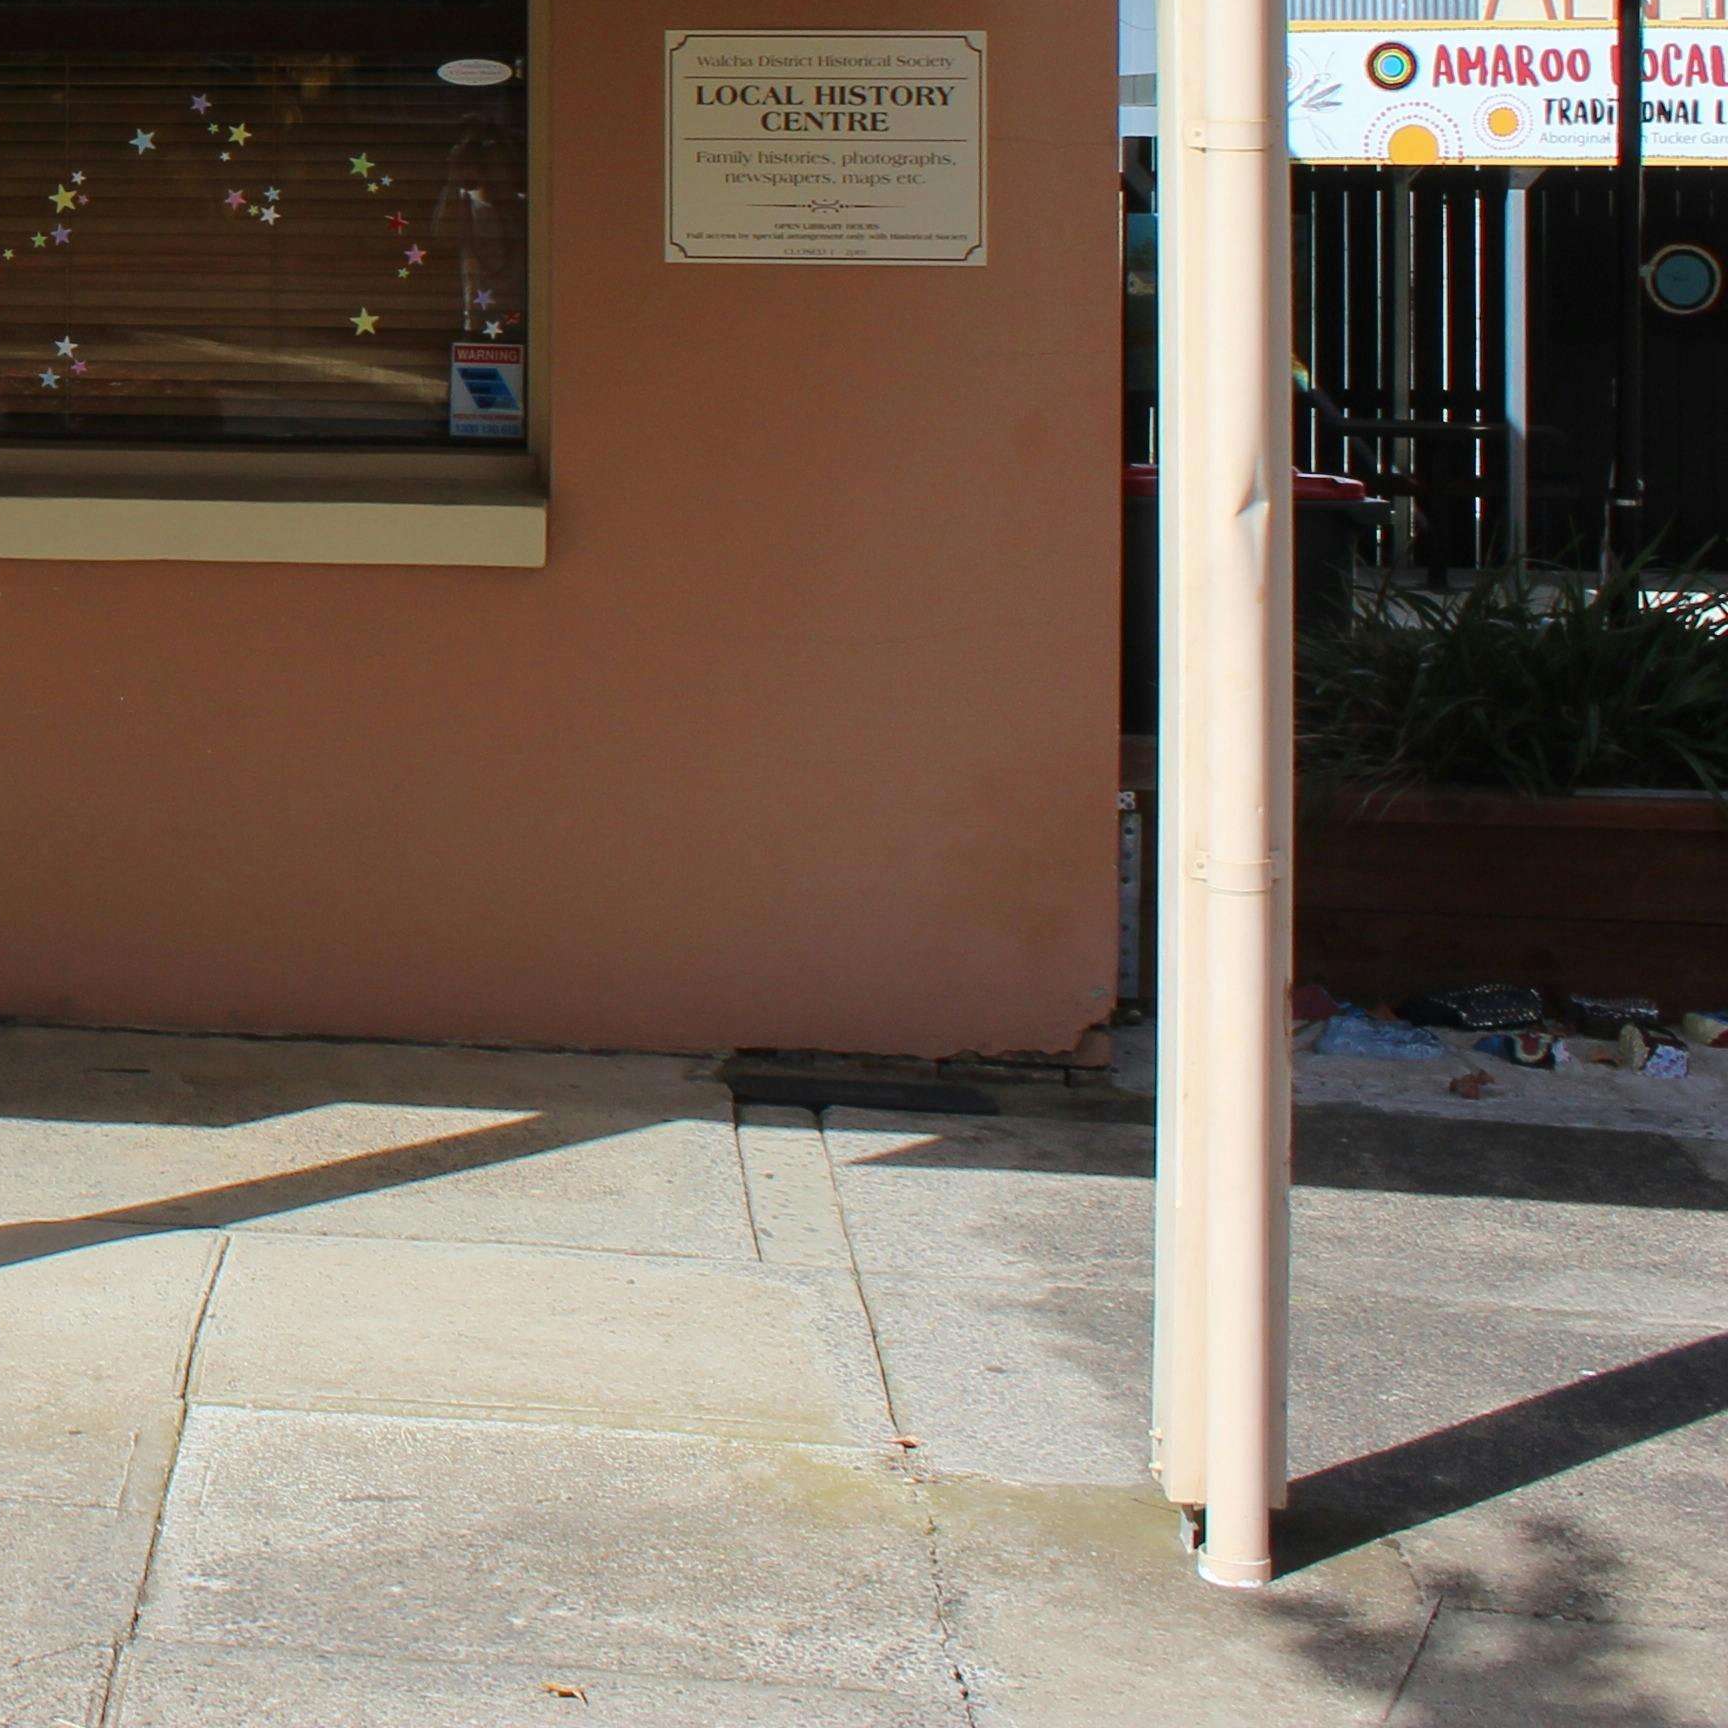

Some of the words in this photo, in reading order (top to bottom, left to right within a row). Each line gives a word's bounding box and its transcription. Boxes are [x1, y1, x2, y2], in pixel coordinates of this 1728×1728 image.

[696, 55, 753, 68] Walcha
[758, 54, 813, 68] District
[817, 54, 892, 68] Historical
[895, 55, 955, 70] Society
[1432, 43, 1591, 87] AMAROO
[695, 84, 803, 106] LOCAL
[815, 84, 956, 107] HISTORY
[760, 111, 890, 132] CENTRE
[1538, 132, 1610, 148] Aboriginal
[1651, 132, 1697, 144] Tucker
[695, 151, 753, 167] Family
[841, 151, 957, 168] photographs,
[841, 172, 891, 187] maps
[456, 349, 518, 362] WARNING
